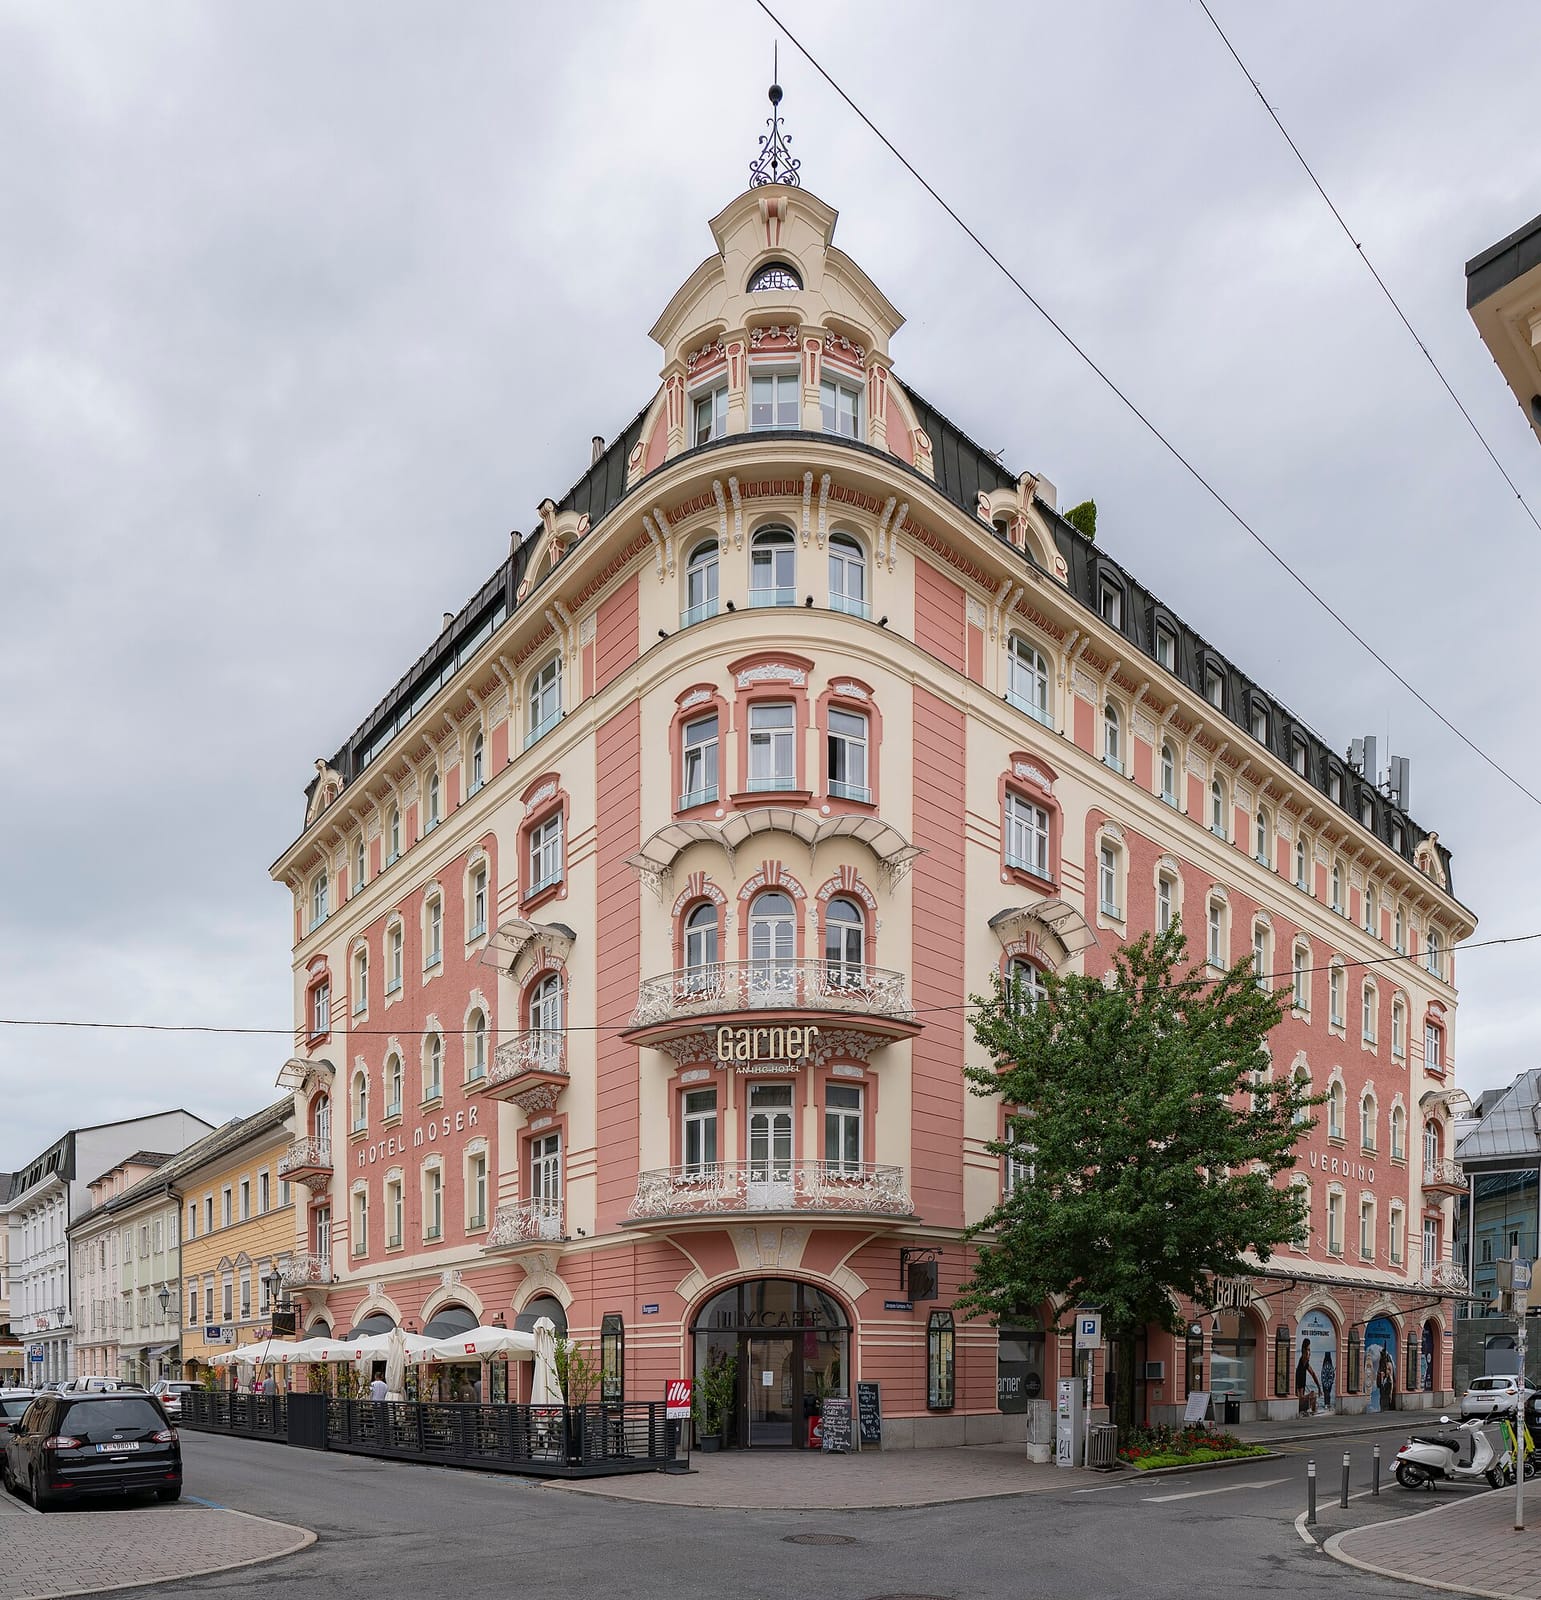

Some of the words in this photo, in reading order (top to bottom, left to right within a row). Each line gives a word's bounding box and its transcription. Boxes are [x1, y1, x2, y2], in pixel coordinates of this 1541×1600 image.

[717, 1026, 819, 1061] Garner
[772, 1065, 801, 1073] HOTEL
[358, 1134, 406, 1168] HOTEL
[413, 1105, 479, 1147] MOSER
[1310, 1151, 1375, 1183] VERDINO
[1216, 1279, 1253, 1308] Garner
[667, 1382, 691, 1406] illy
[998, 1377, 1021, 1392] arner
